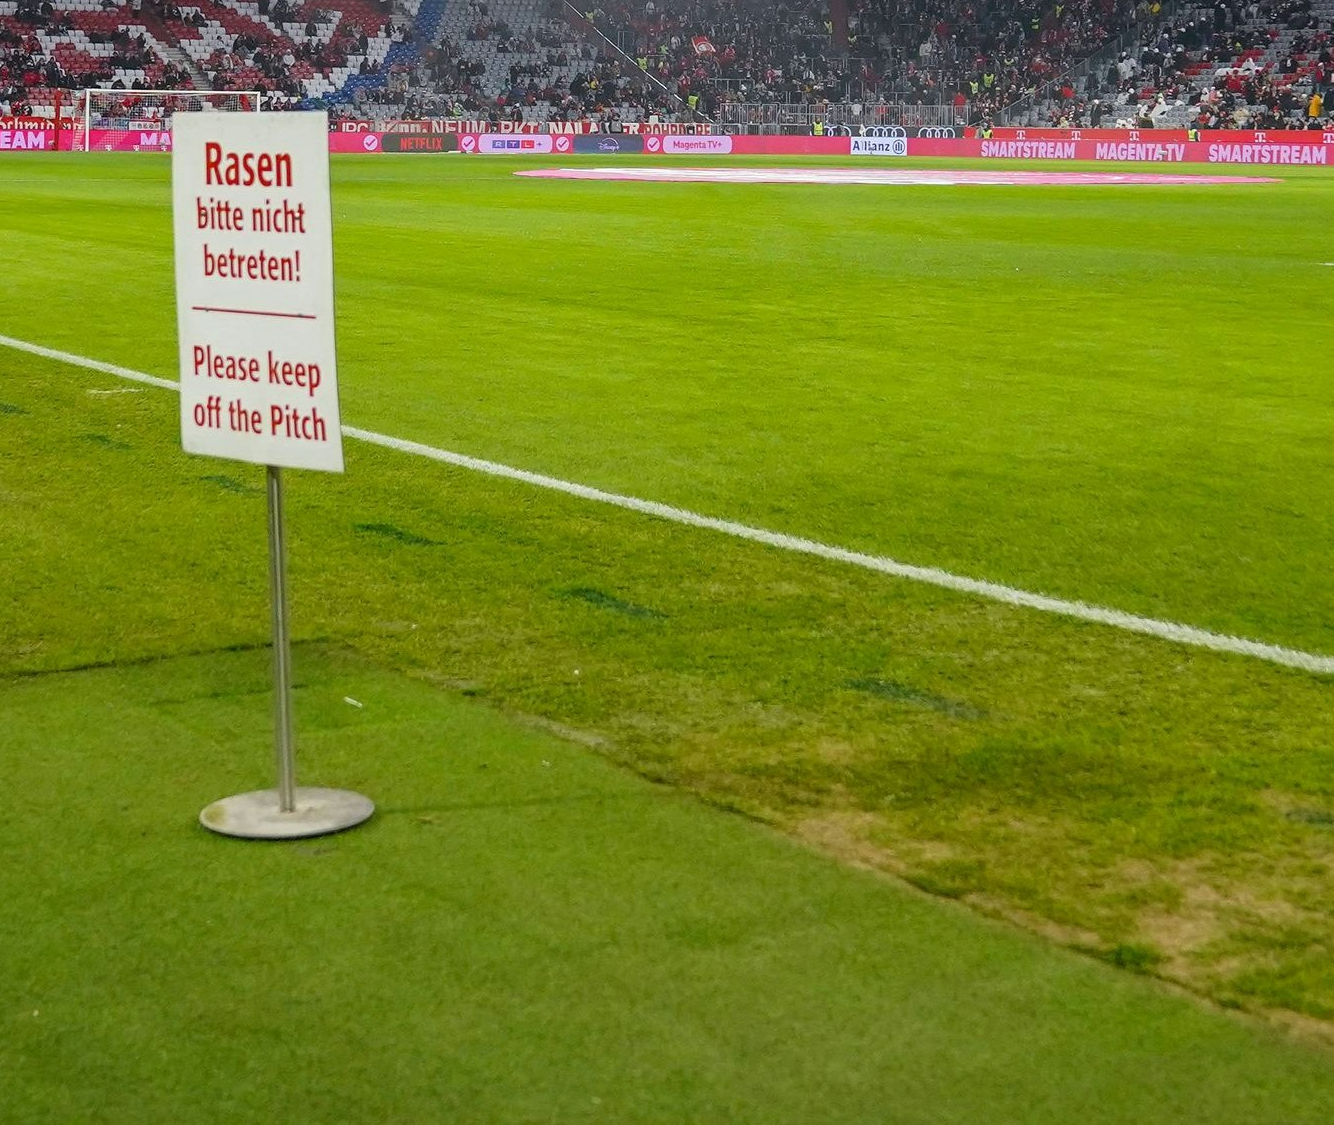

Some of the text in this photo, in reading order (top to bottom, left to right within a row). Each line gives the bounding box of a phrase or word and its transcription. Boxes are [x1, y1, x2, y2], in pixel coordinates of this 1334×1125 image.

[399, 136, 443, 151] NETFLIX
[672, 139, 723, 151] Magenta TV+
[981, 140, 1076, 159] SMARTSTREAM
[1096, 143, 1185, 162] MAGENTA TV
[1208, 143, 1327, 165] SMARTSTREAM
[205, 141, 294, 188] Rasen
[196, 196, 306, 234] bitte nicht
[203, 243, 301, 283] betreten!
[193, 344, 322, 398] Please keep
[194, 395, 327, 442] off the Pitch
